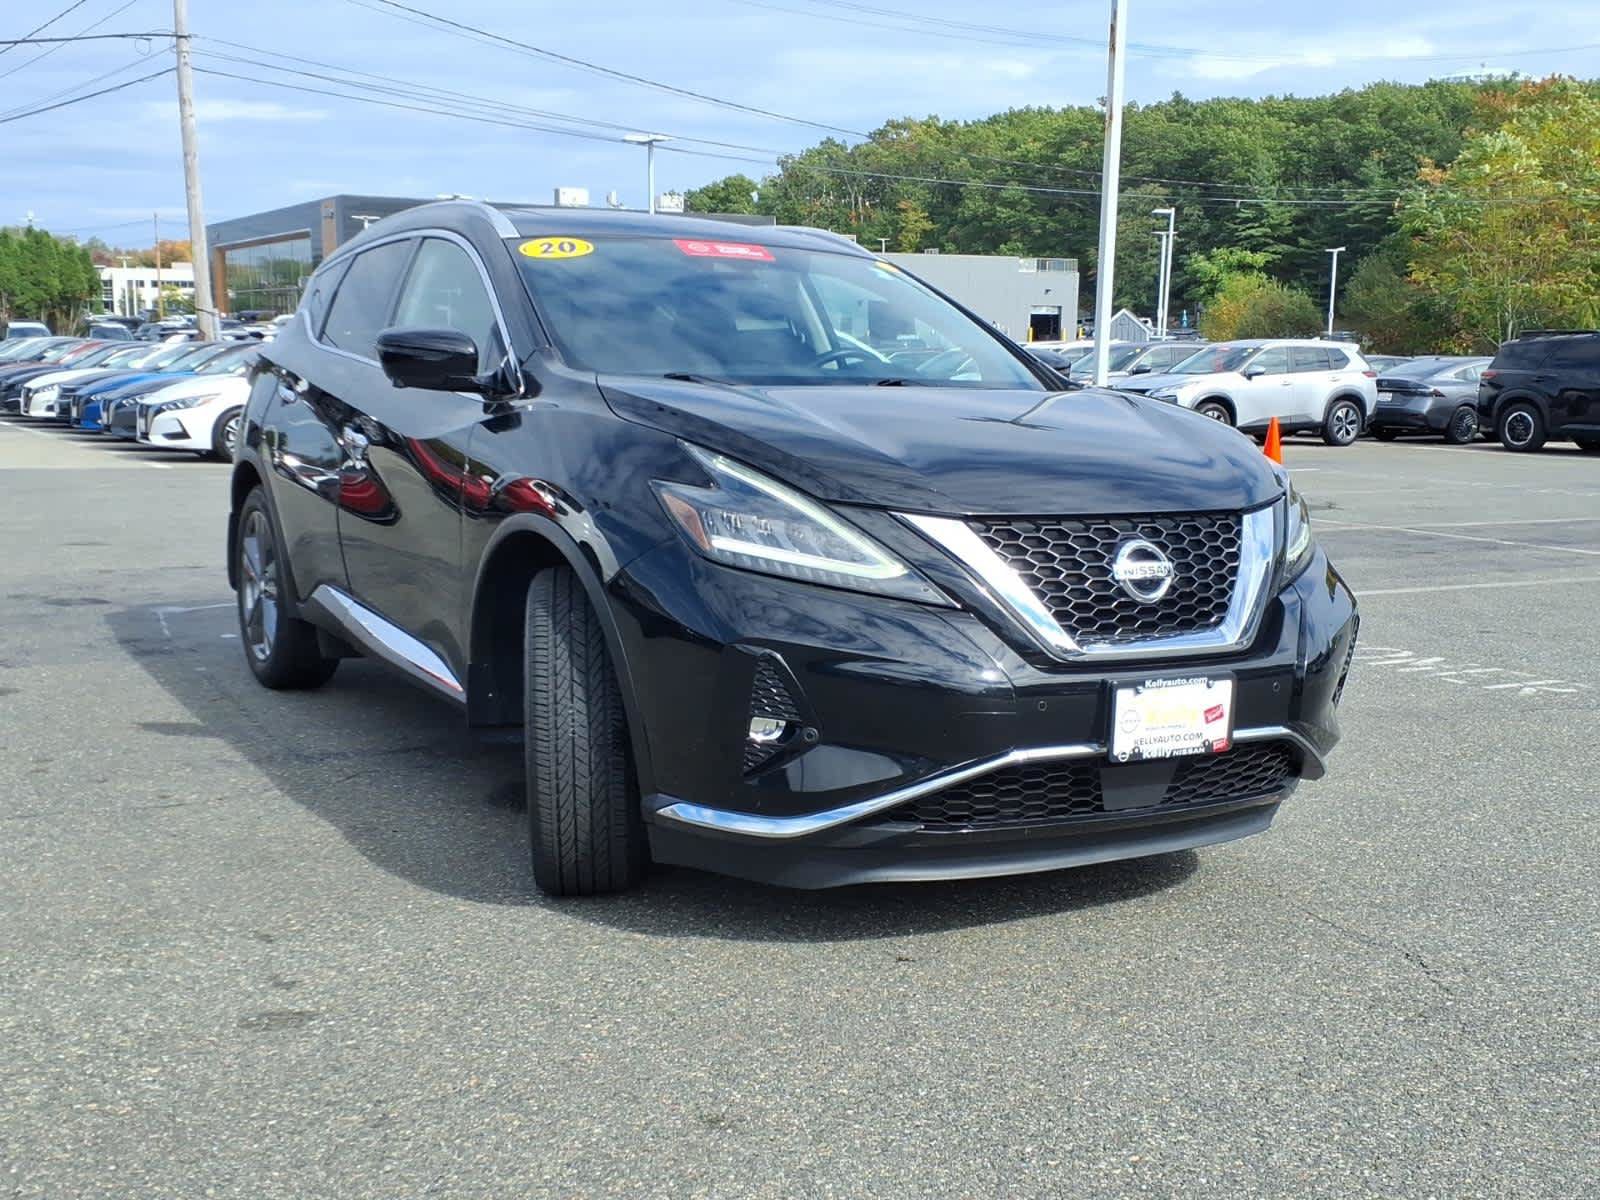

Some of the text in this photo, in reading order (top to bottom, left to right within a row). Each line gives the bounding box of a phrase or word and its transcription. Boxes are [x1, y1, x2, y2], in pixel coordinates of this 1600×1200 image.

[540, 242, 577, 254] 20
[1123, 565, 1170, 576] NISSAN
[1144, 677, 1208, 689] Kellyauto.com
[1134, 732, 1204, 746] KELLYAUTO.COM
